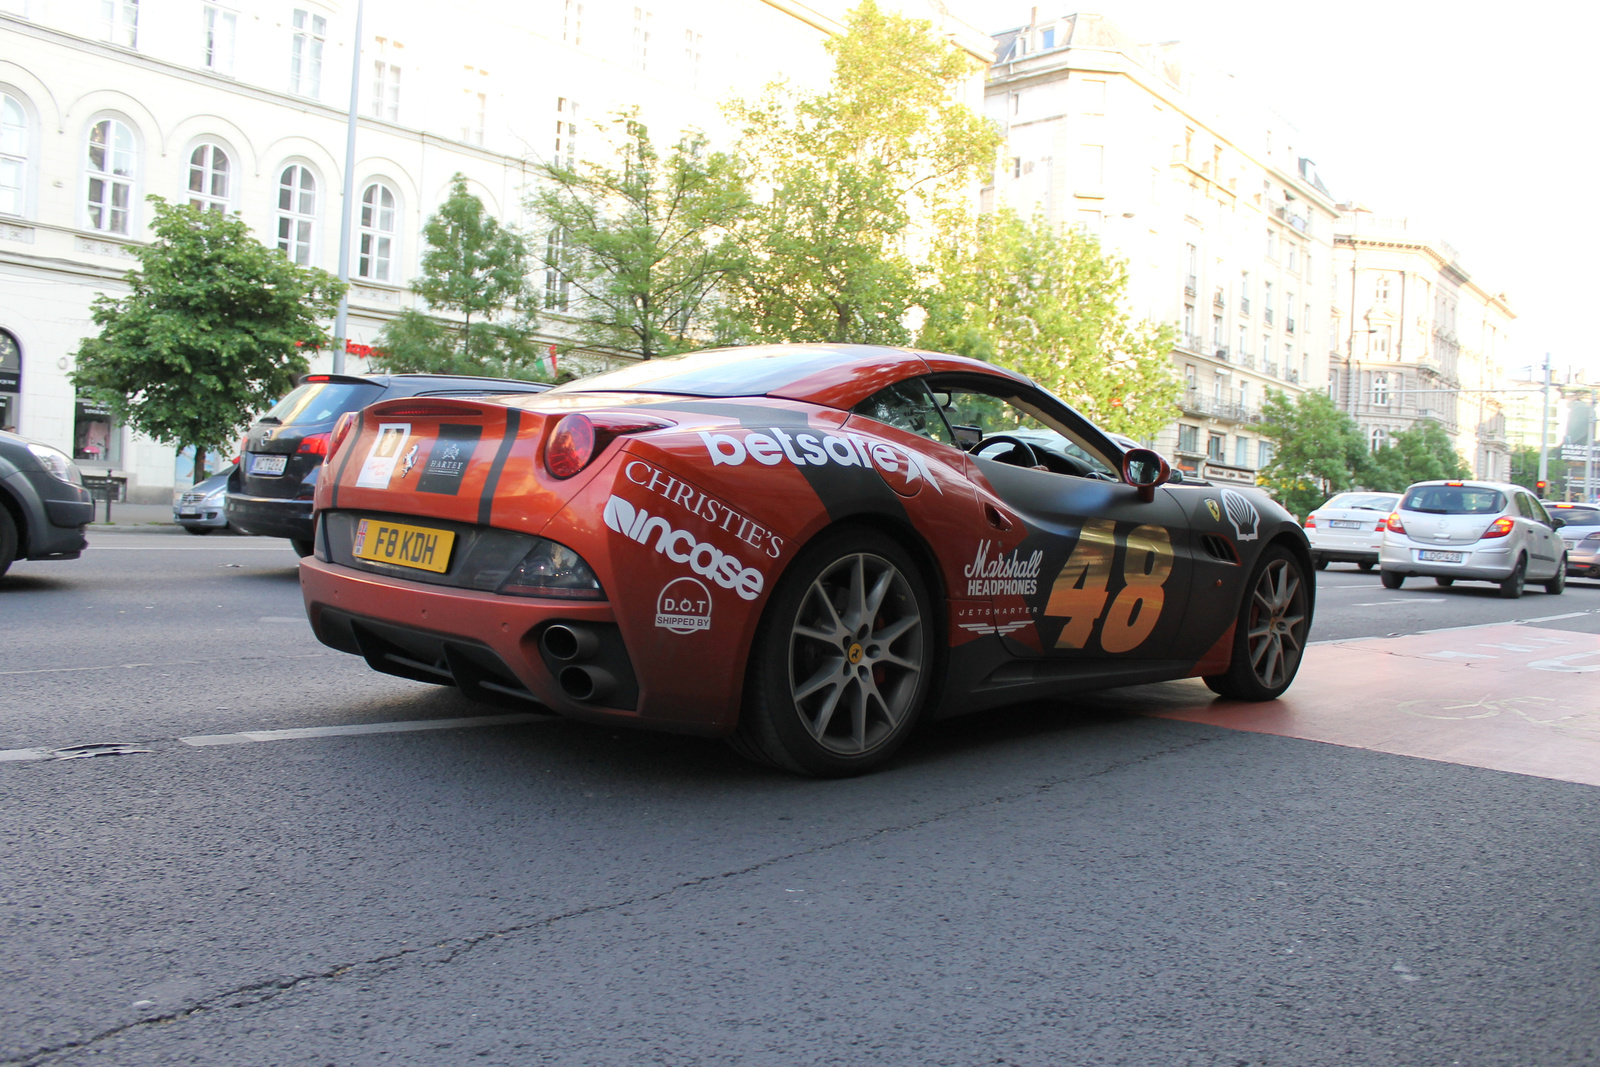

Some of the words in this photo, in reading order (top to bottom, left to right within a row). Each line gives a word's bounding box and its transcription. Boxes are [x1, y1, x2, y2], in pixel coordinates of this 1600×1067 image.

[697, 427, 899, 473] betsafe
[625, 460, 784, 559] CHRISTIE'S
[373, 527, 399, 558] F8
[399, 530, 438, 565] KDH
[628, 508, 764, 601] incase
[964, 539, 1043, 578] Marshall
[967, 580, 1037, 596] HEADPHONES
[1043, 516, 1174, 654] 48
[656, 616, 695, 626] SHIPPED
[697, 618, 709, 627] BY
[959, 607, 1038, 616] JETSMARTER
